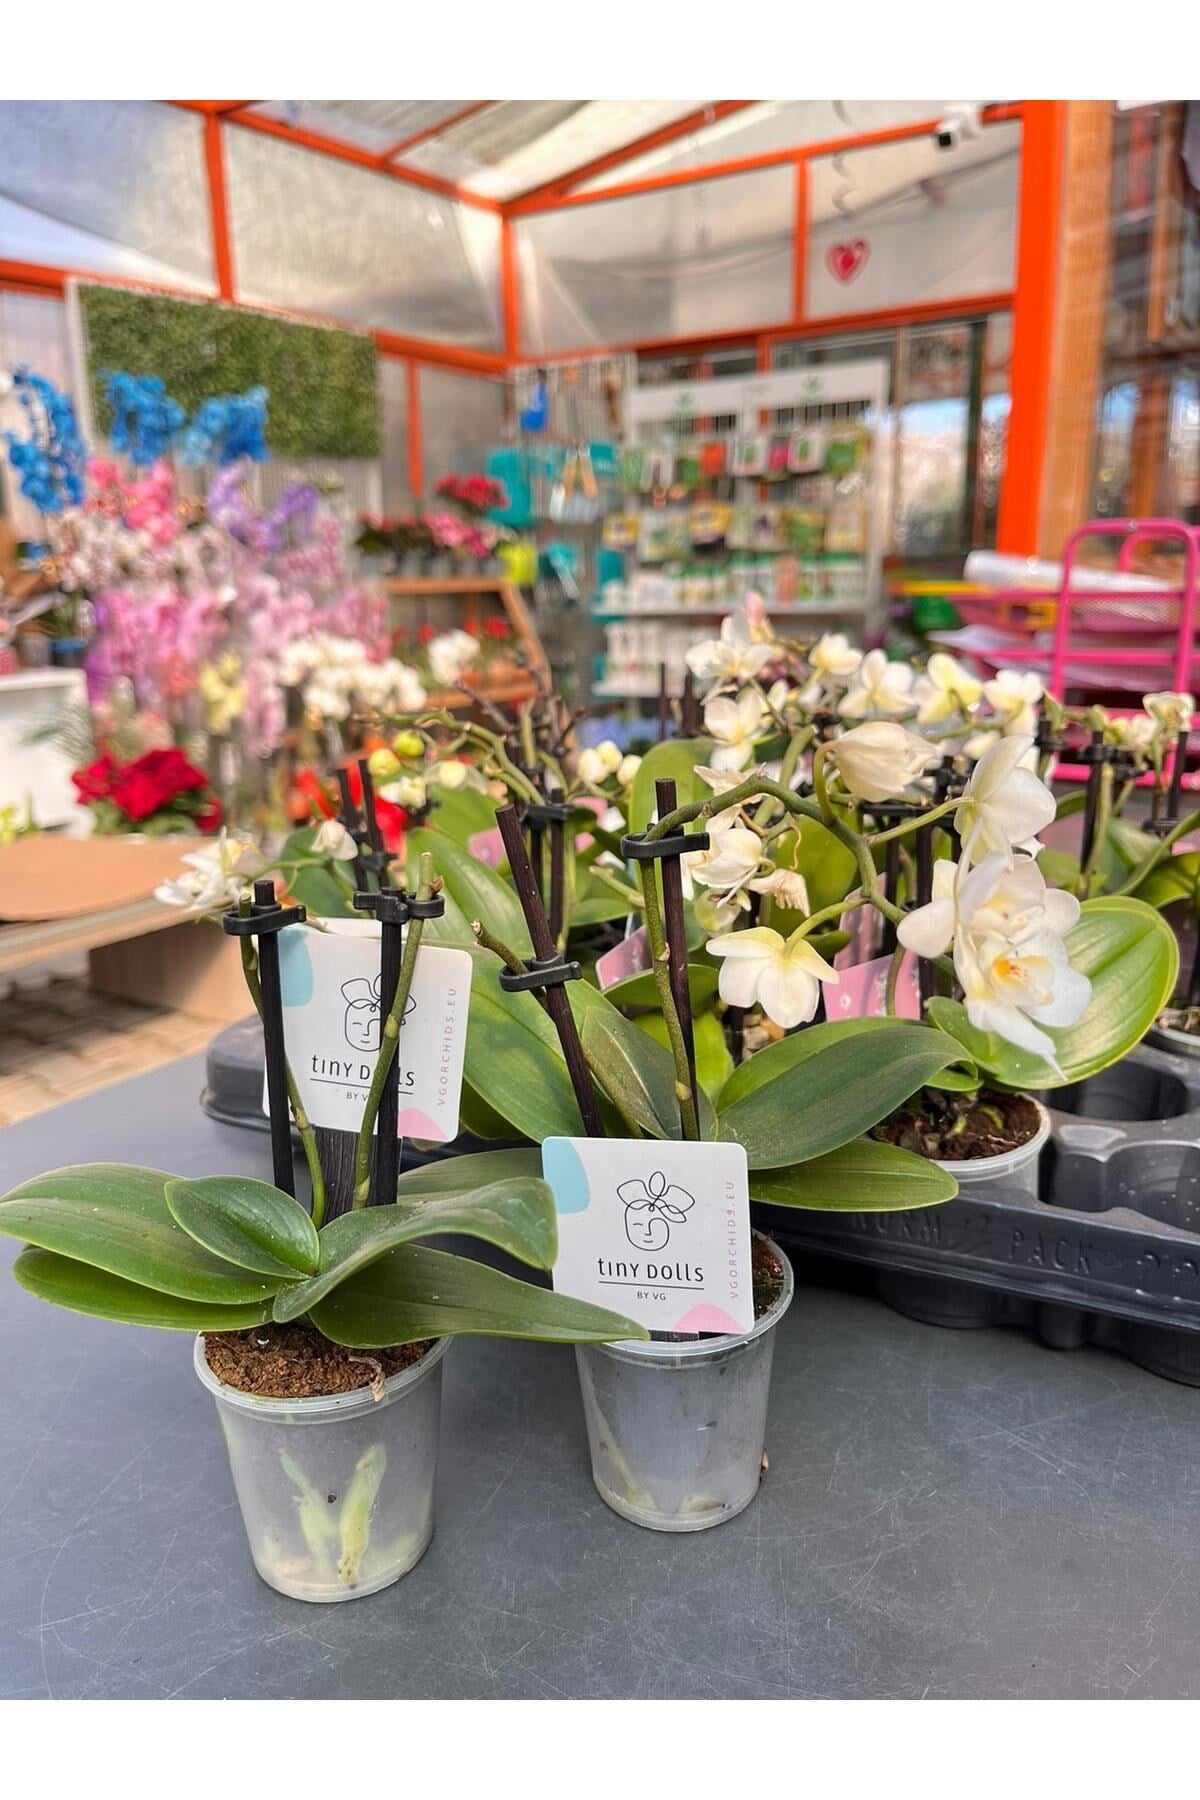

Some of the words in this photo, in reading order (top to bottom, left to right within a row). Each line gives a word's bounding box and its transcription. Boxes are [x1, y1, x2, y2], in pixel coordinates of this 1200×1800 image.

[437, 988, 456, 1106] VGORCHIDS.EU
[346, 1091, 359, 1100] BY
[726, 1182, 739, 1299] VGORCHIDS.EU
[636, 1291, 650, 1300] BY
[652, 1292, 667, 1301] VG
